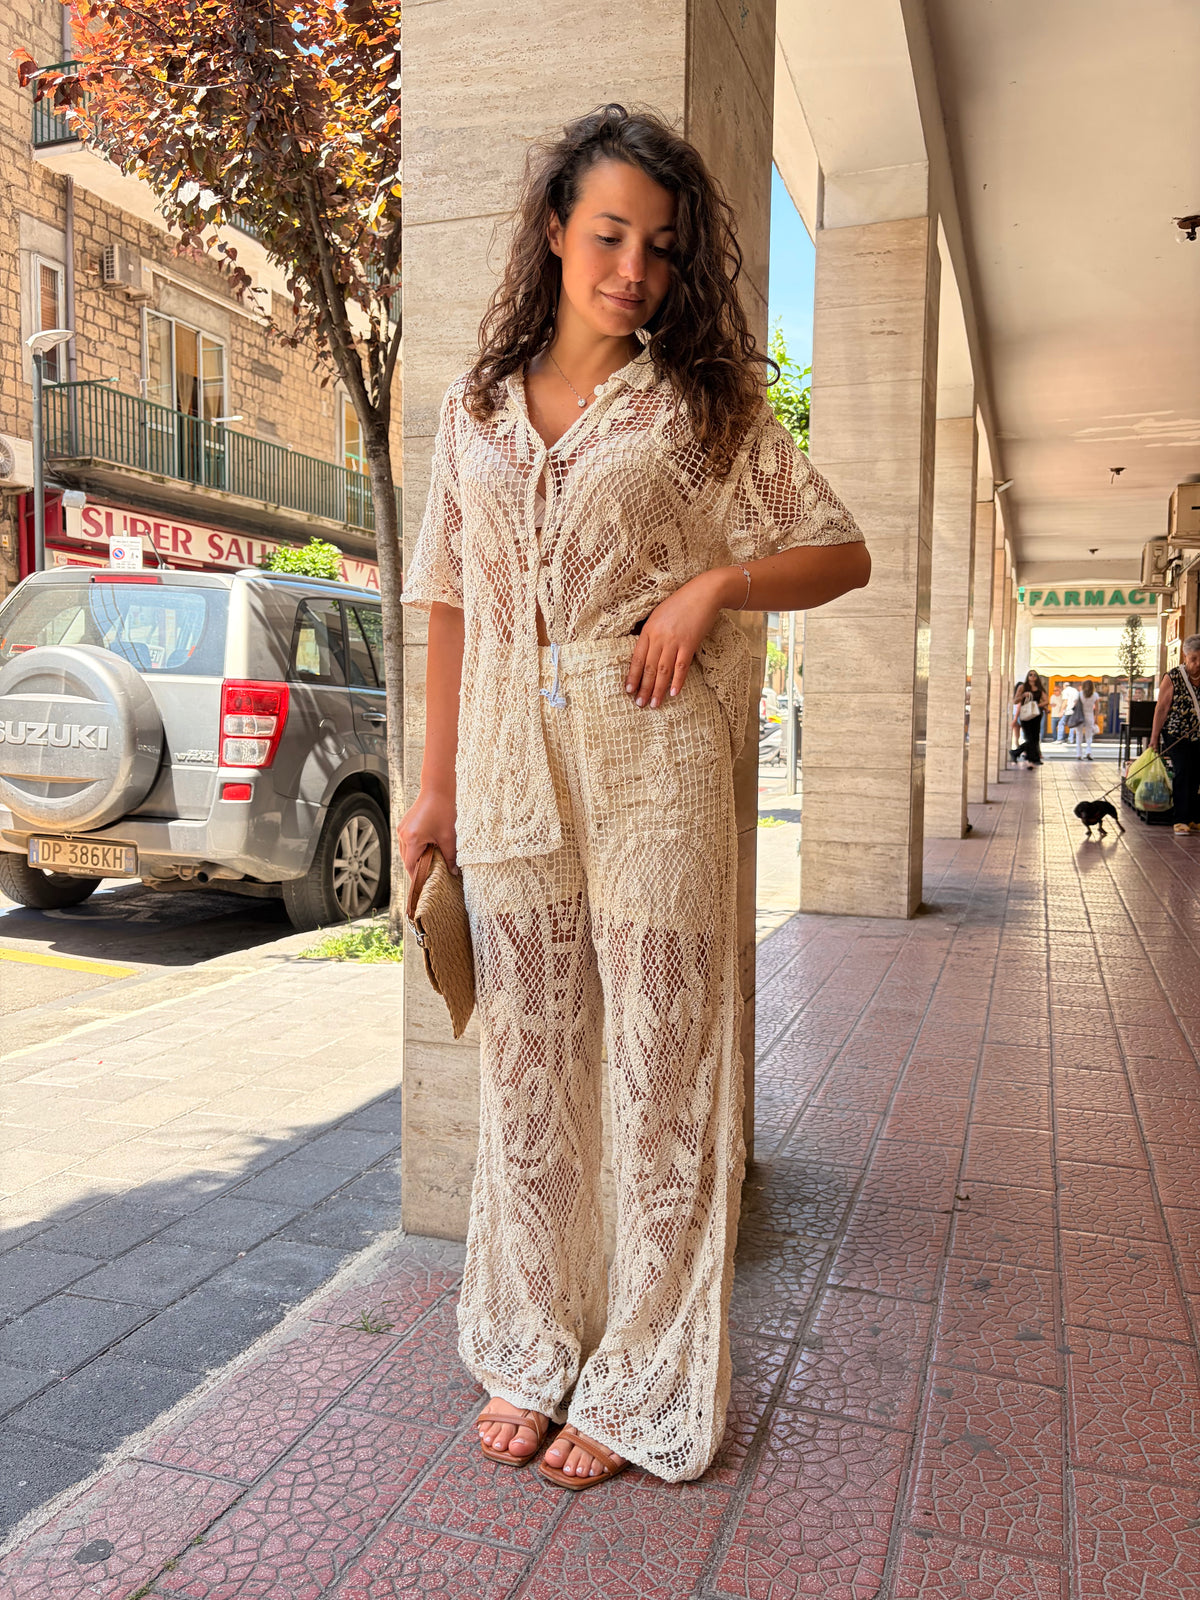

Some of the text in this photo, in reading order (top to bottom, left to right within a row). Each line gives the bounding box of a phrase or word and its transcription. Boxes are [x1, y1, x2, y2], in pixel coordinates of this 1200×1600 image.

[82, 506, 193, 556] SUPER
[0, 720, 109, 750] UZUKI
[41, 841, 62, 862] DP
[68, 843, 123, 869] 386KH
